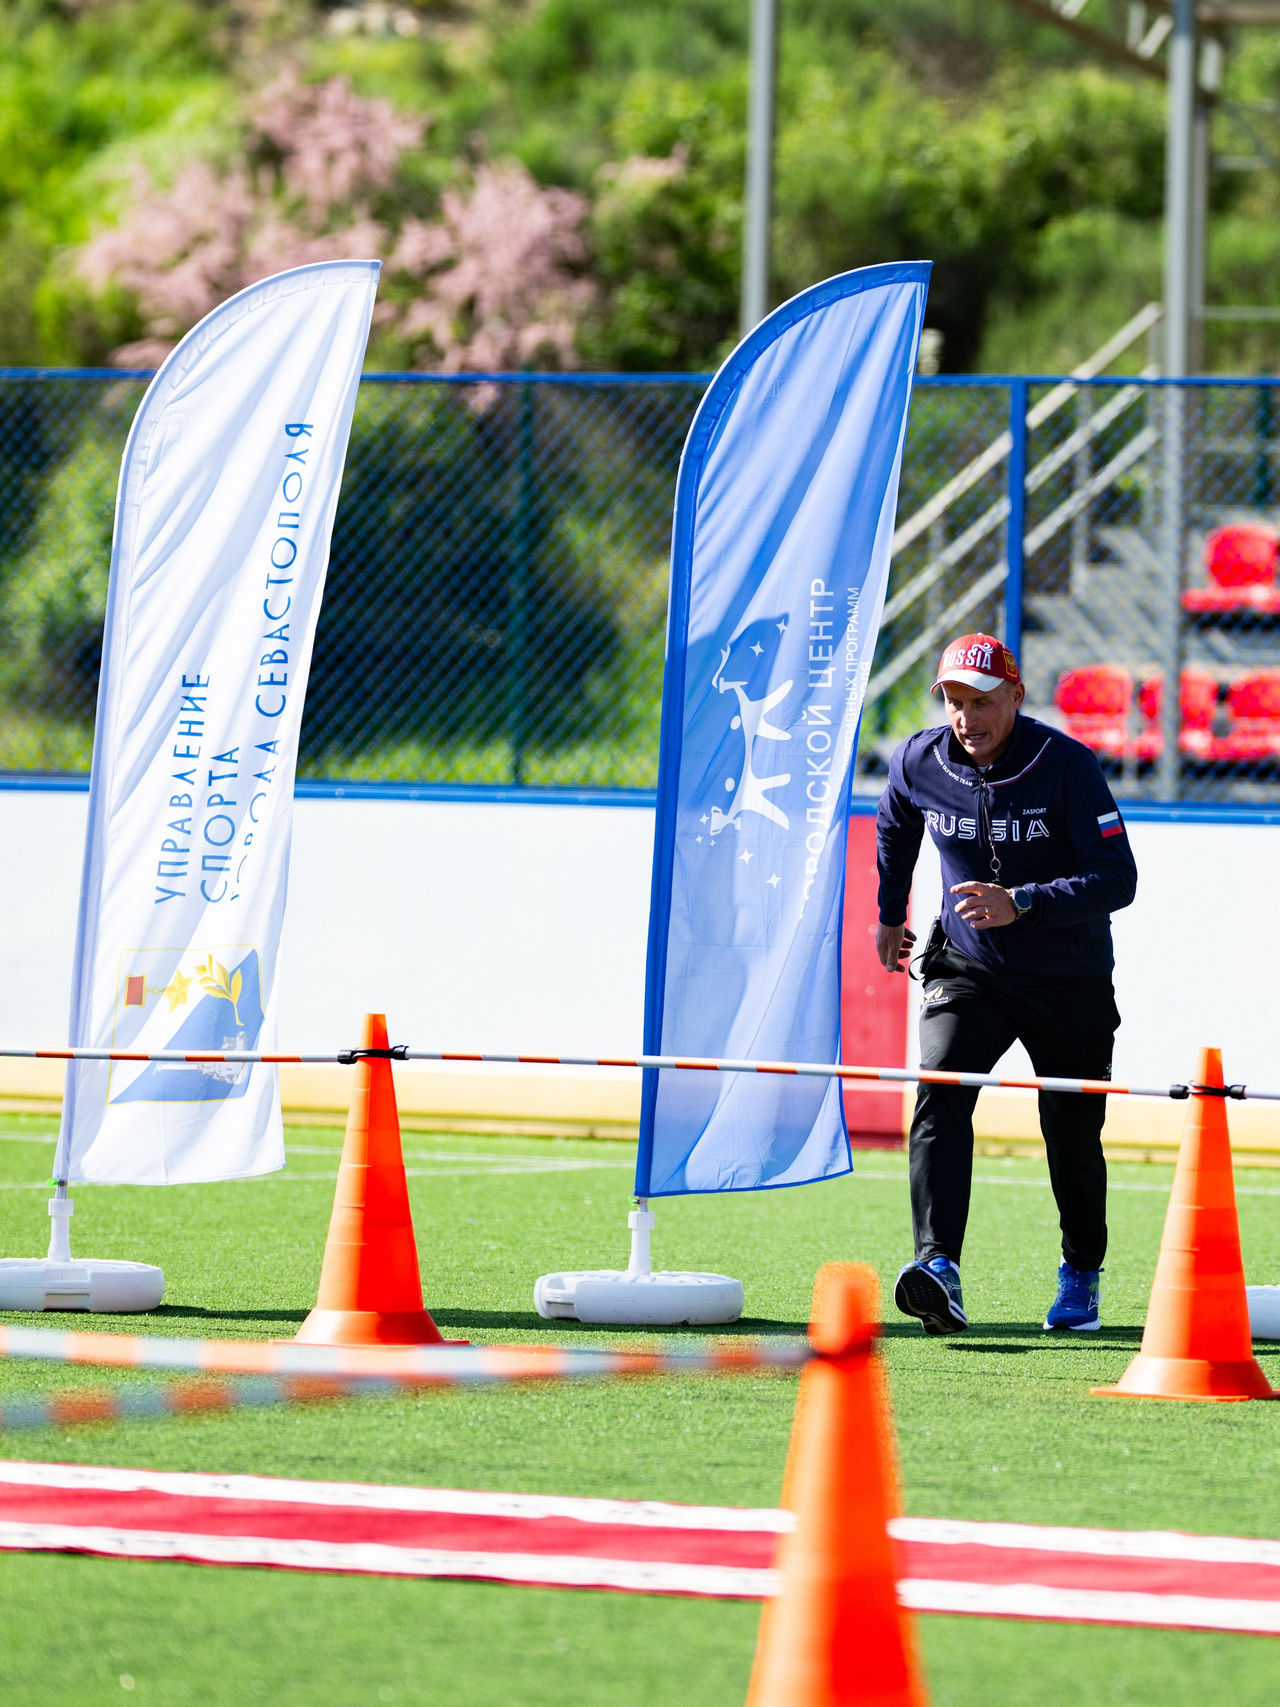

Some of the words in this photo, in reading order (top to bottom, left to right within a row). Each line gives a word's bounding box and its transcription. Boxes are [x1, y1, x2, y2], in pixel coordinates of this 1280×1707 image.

[255, 423, 314, 718] СЕВАСТОПОЛЯ
[807, 578, 837, 688] ЦЕНТР
[845, 587, 860, 672] ПРОГРАММ
[942, 648, 993, 671] RUSSIA
[156, 674, 209, 904] УПРАВЛЕНИЕ
[200, 747, 240, 903] СПОРТА
[799, 705, 833, 919] РОДСКОЙ
[926, 808, 1050, 842] RUSSIA
[959, 777, 973, 787] TEAM
